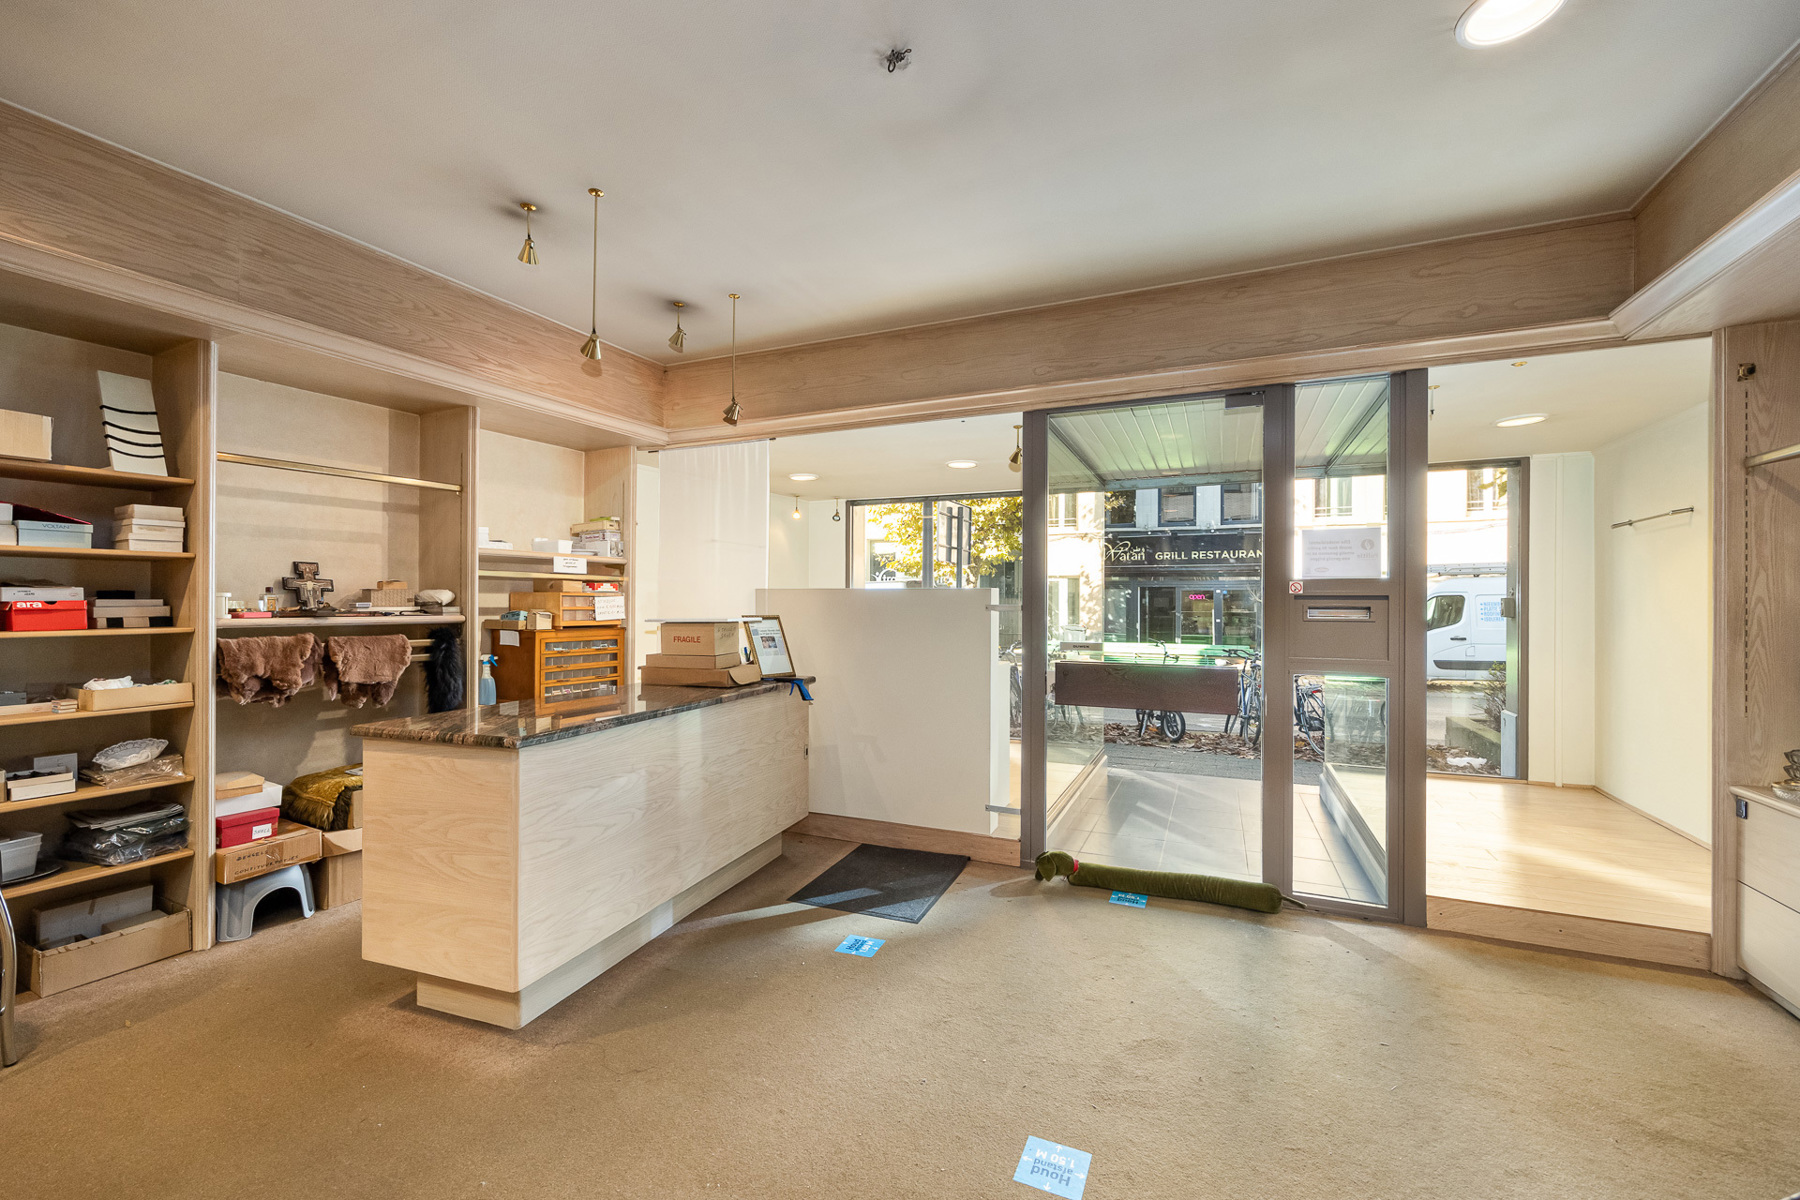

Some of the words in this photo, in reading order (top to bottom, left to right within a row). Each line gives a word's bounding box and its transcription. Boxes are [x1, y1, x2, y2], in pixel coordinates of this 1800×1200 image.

[1155, 551, 1188, 560] GRILL
[1189, 593, 1205, 601] open
[673, 635, 701, 644] FRAGILE
[1035, 1148, 1048, 1160] M
[1033, 1158, 1074, 1175] afstand
[1050, 1153, 1075, 1168] 1.50
[1030, 1164, 1071, 1187] Houd
